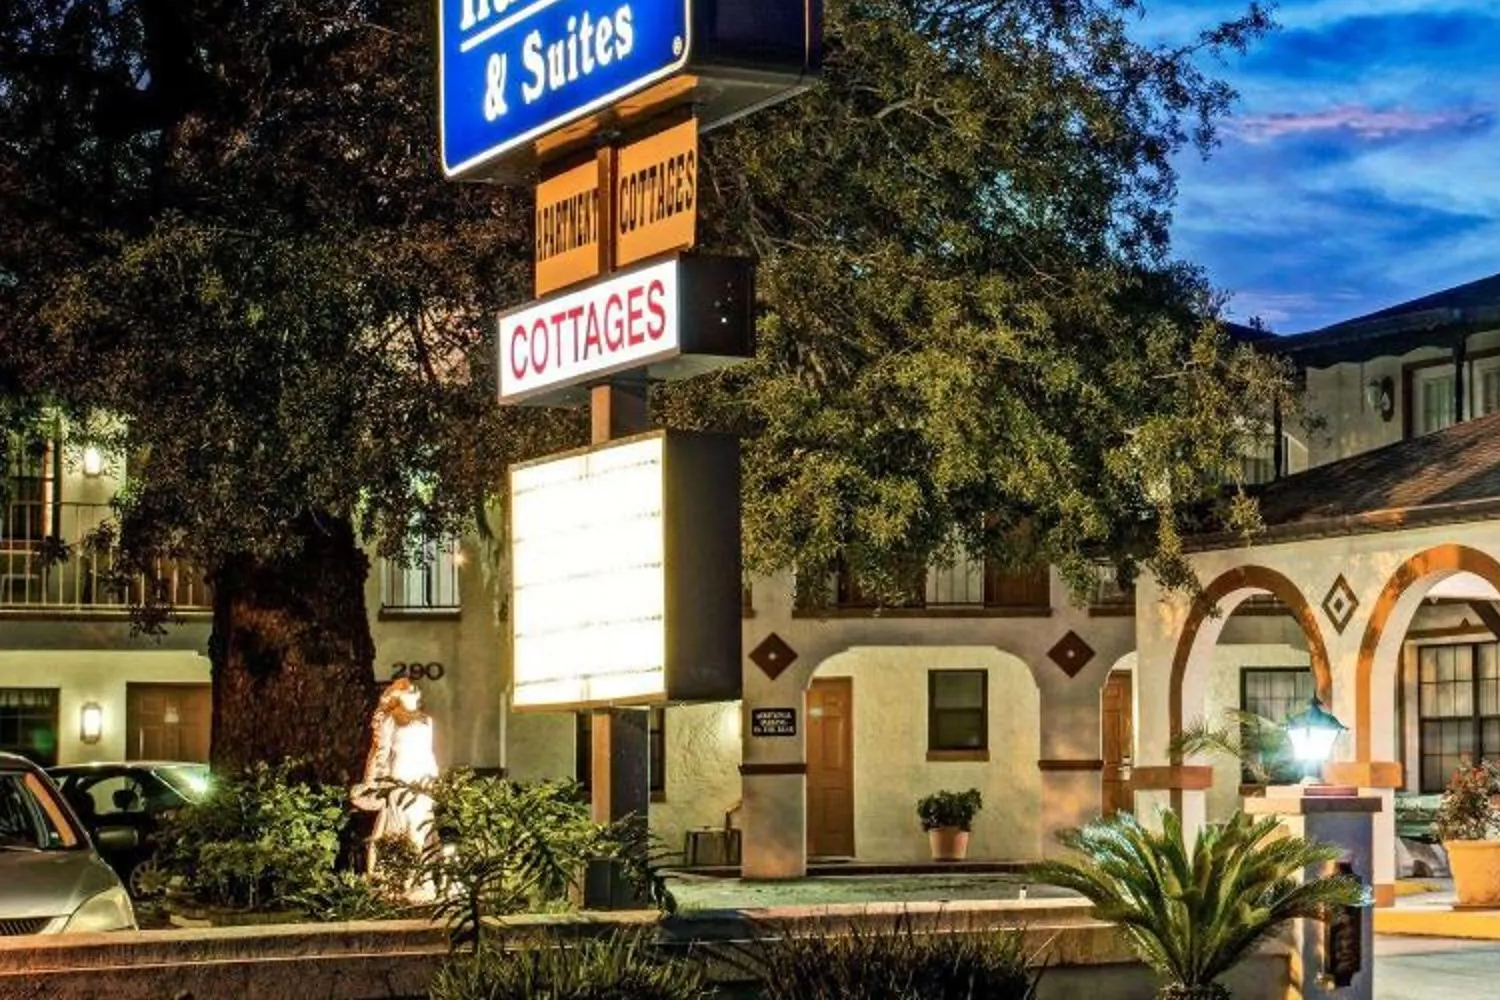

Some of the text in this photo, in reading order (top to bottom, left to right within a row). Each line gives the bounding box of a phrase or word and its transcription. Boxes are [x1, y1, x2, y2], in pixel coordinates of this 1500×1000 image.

[484, 4, 634, 121] & Suites
[619, 149, 694, 235] COTTAGES
[510, 279, 667, 379] COTTAGES
